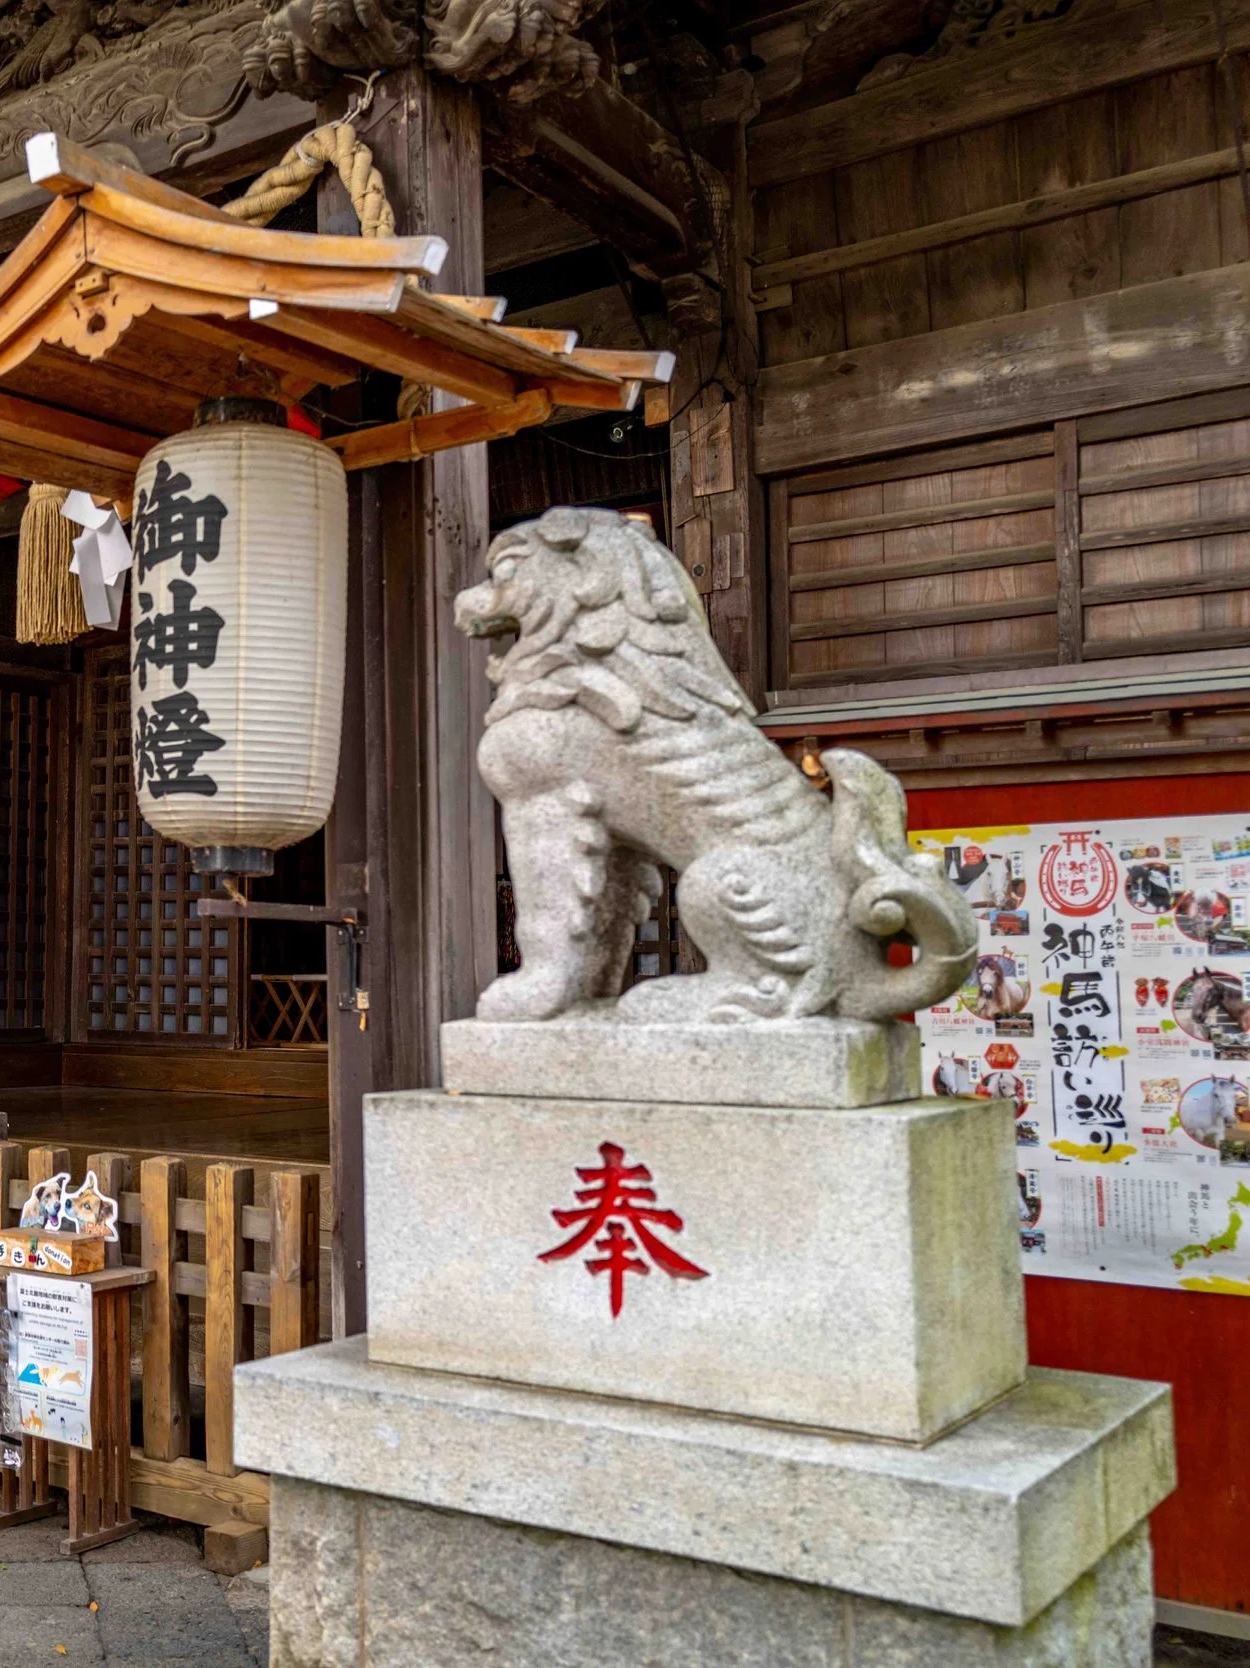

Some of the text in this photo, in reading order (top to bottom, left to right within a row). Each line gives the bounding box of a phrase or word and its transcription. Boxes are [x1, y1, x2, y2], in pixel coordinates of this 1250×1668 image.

[132, 459, 228, 798] 御神燈
[44, 1246, 71, 1266] donation
[536, 1140, 711, 1319] 奉
